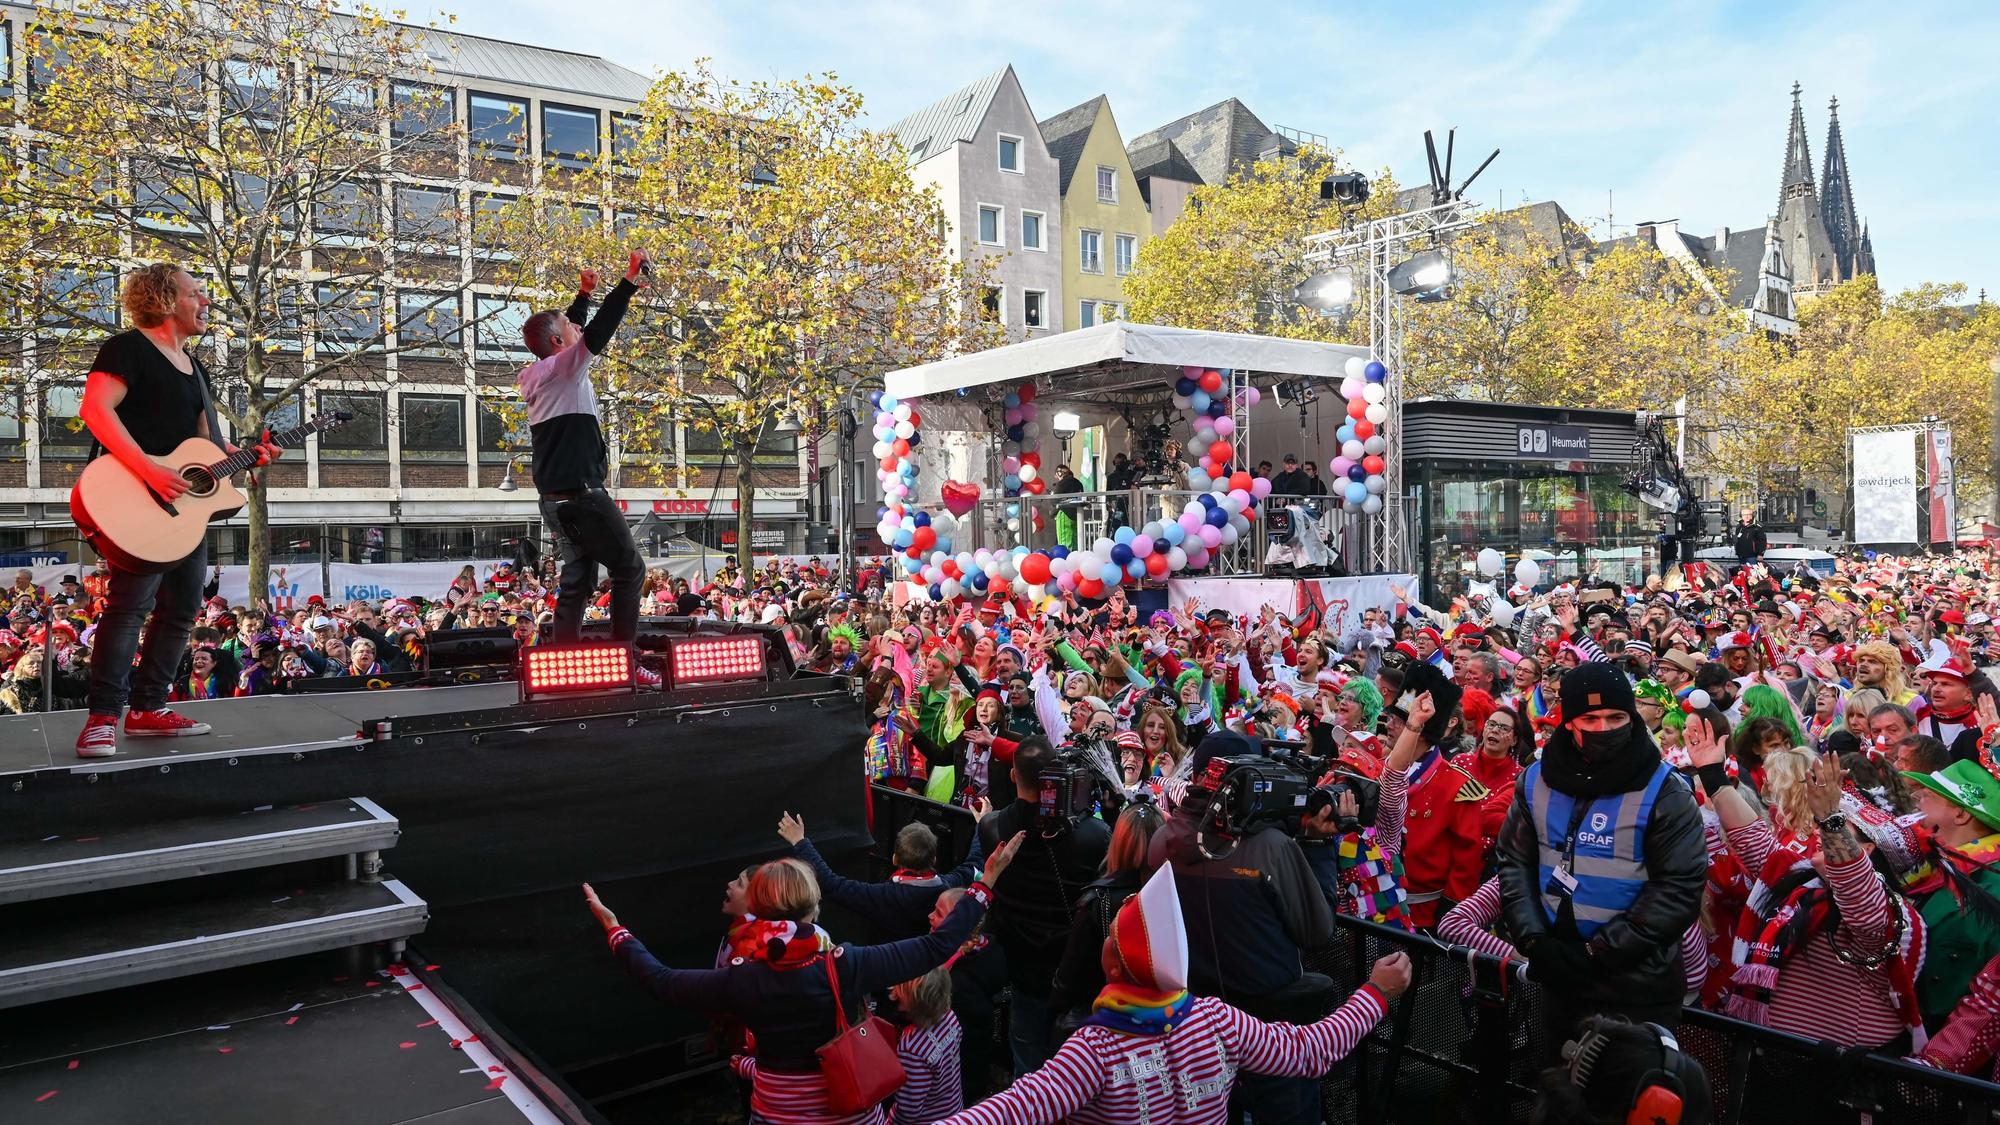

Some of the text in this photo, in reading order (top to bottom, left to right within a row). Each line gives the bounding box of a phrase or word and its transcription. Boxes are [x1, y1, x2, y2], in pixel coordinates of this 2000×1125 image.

[1551, 436, 1587, 449] Heumarkt
[1858, 475, 1911, 488] @wdrjeck
[653, 500, 709, 513] KIOSK
[31, 557, 60, 568] WC
[1579, 831, 1614, 846] GRAF
[1112, 1058, 1164, 1081] BAUER
